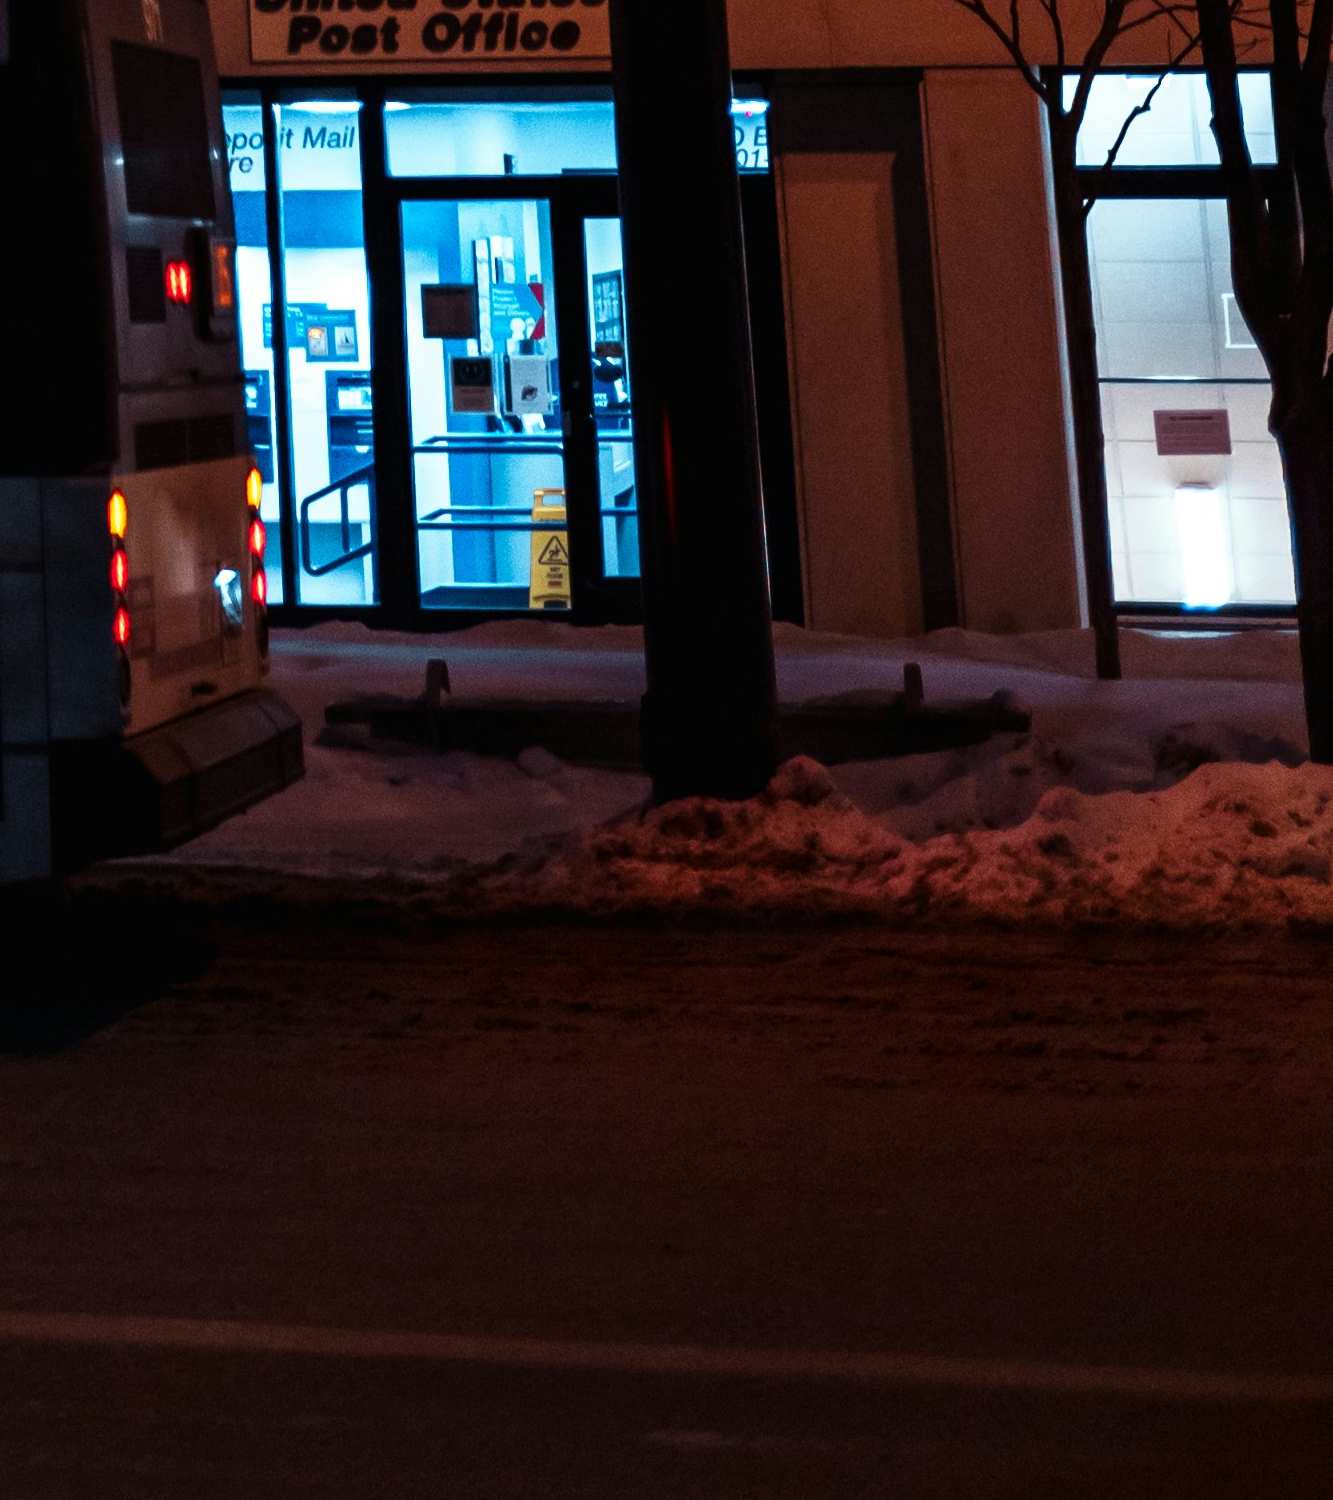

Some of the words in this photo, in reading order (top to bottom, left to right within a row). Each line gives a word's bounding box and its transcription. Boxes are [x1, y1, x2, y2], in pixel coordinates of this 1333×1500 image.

[288, 15, 400, 54] Post
[422, 11, 581, 52] Office
[302, 125, 355, 149] Mail
